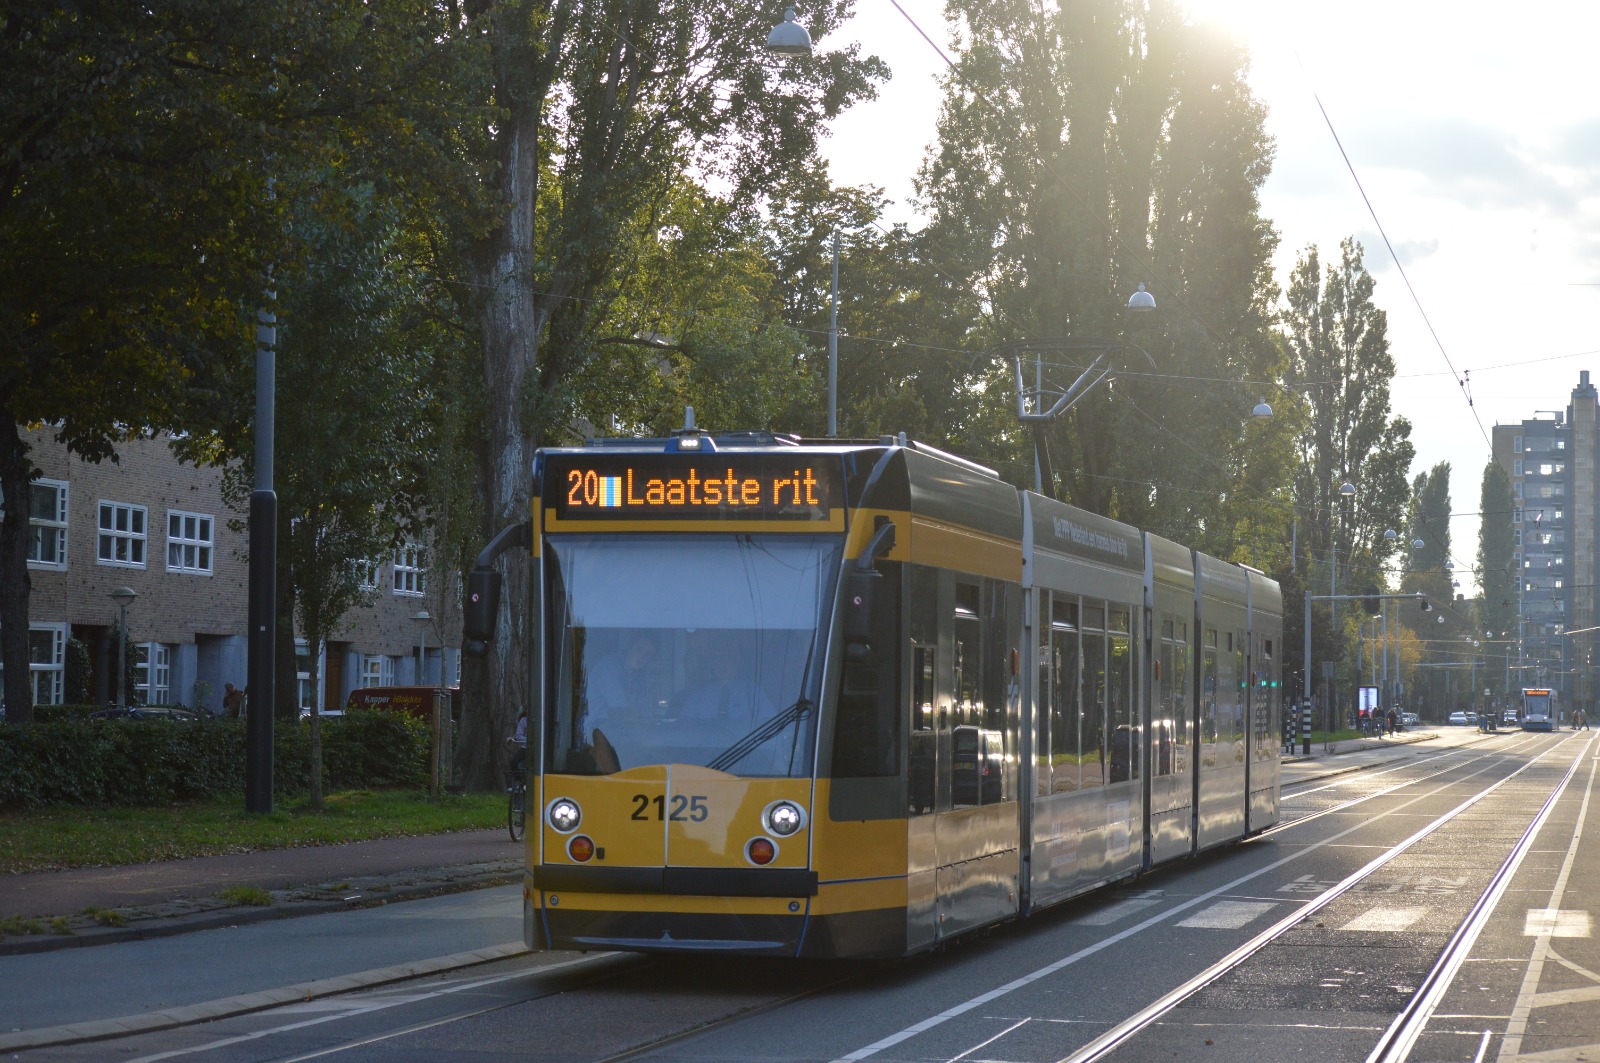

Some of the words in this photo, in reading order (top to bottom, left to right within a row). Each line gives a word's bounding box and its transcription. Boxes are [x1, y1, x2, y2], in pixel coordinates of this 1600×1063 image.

[568, 469, 598, 505] 20
[627, 468, 760, 505] Laatste
[773, 468, 819, 505] rit
[364, 695, 390, 704] Kapper
[631, 794, 708, 822] 2125
[1275, 882, 1461, 895] BUS
